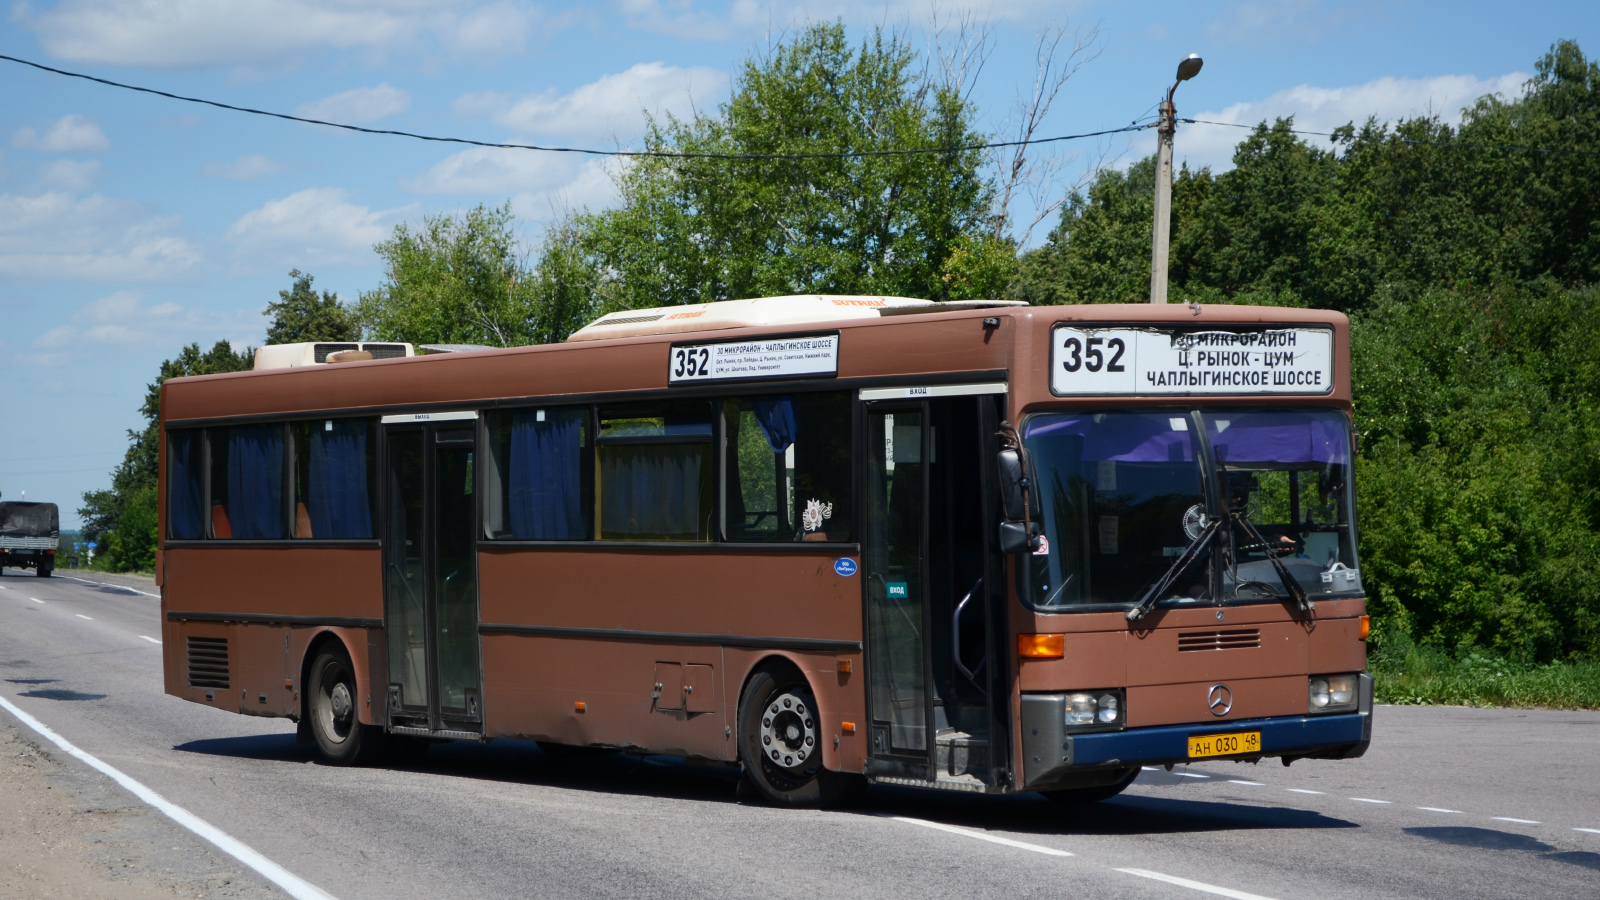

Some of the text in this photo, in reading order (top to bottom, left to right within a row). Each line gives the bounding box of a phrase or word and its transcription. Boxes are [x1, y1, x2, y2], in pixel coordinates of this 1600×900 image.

[724, 343, 761, 354] МИКРОРАЙОН
[766, 341, 811, 351] ЧАПЛЫГИНСКОЕ
[812, 339, 832, 349] ШОССЕ
[1197, 331, 1296, 347] МИКРОРАЙОН
[674, 347, 710, 378] 352
[1063, 337, 1126, 373] 352
[1178, 351, 1193, 369] Ц.
[1197, 351, 1250, 366] РЫНОК
[1264, 351, 1294, 369] ЦУМ
[1147, 370, 1322, 386] ЧАПЛЫГИНСКОЕ ШОССЕ
[889, 586, 905, 595] ВХОД
[1195, 733, 1257, 755] АН 030 48
